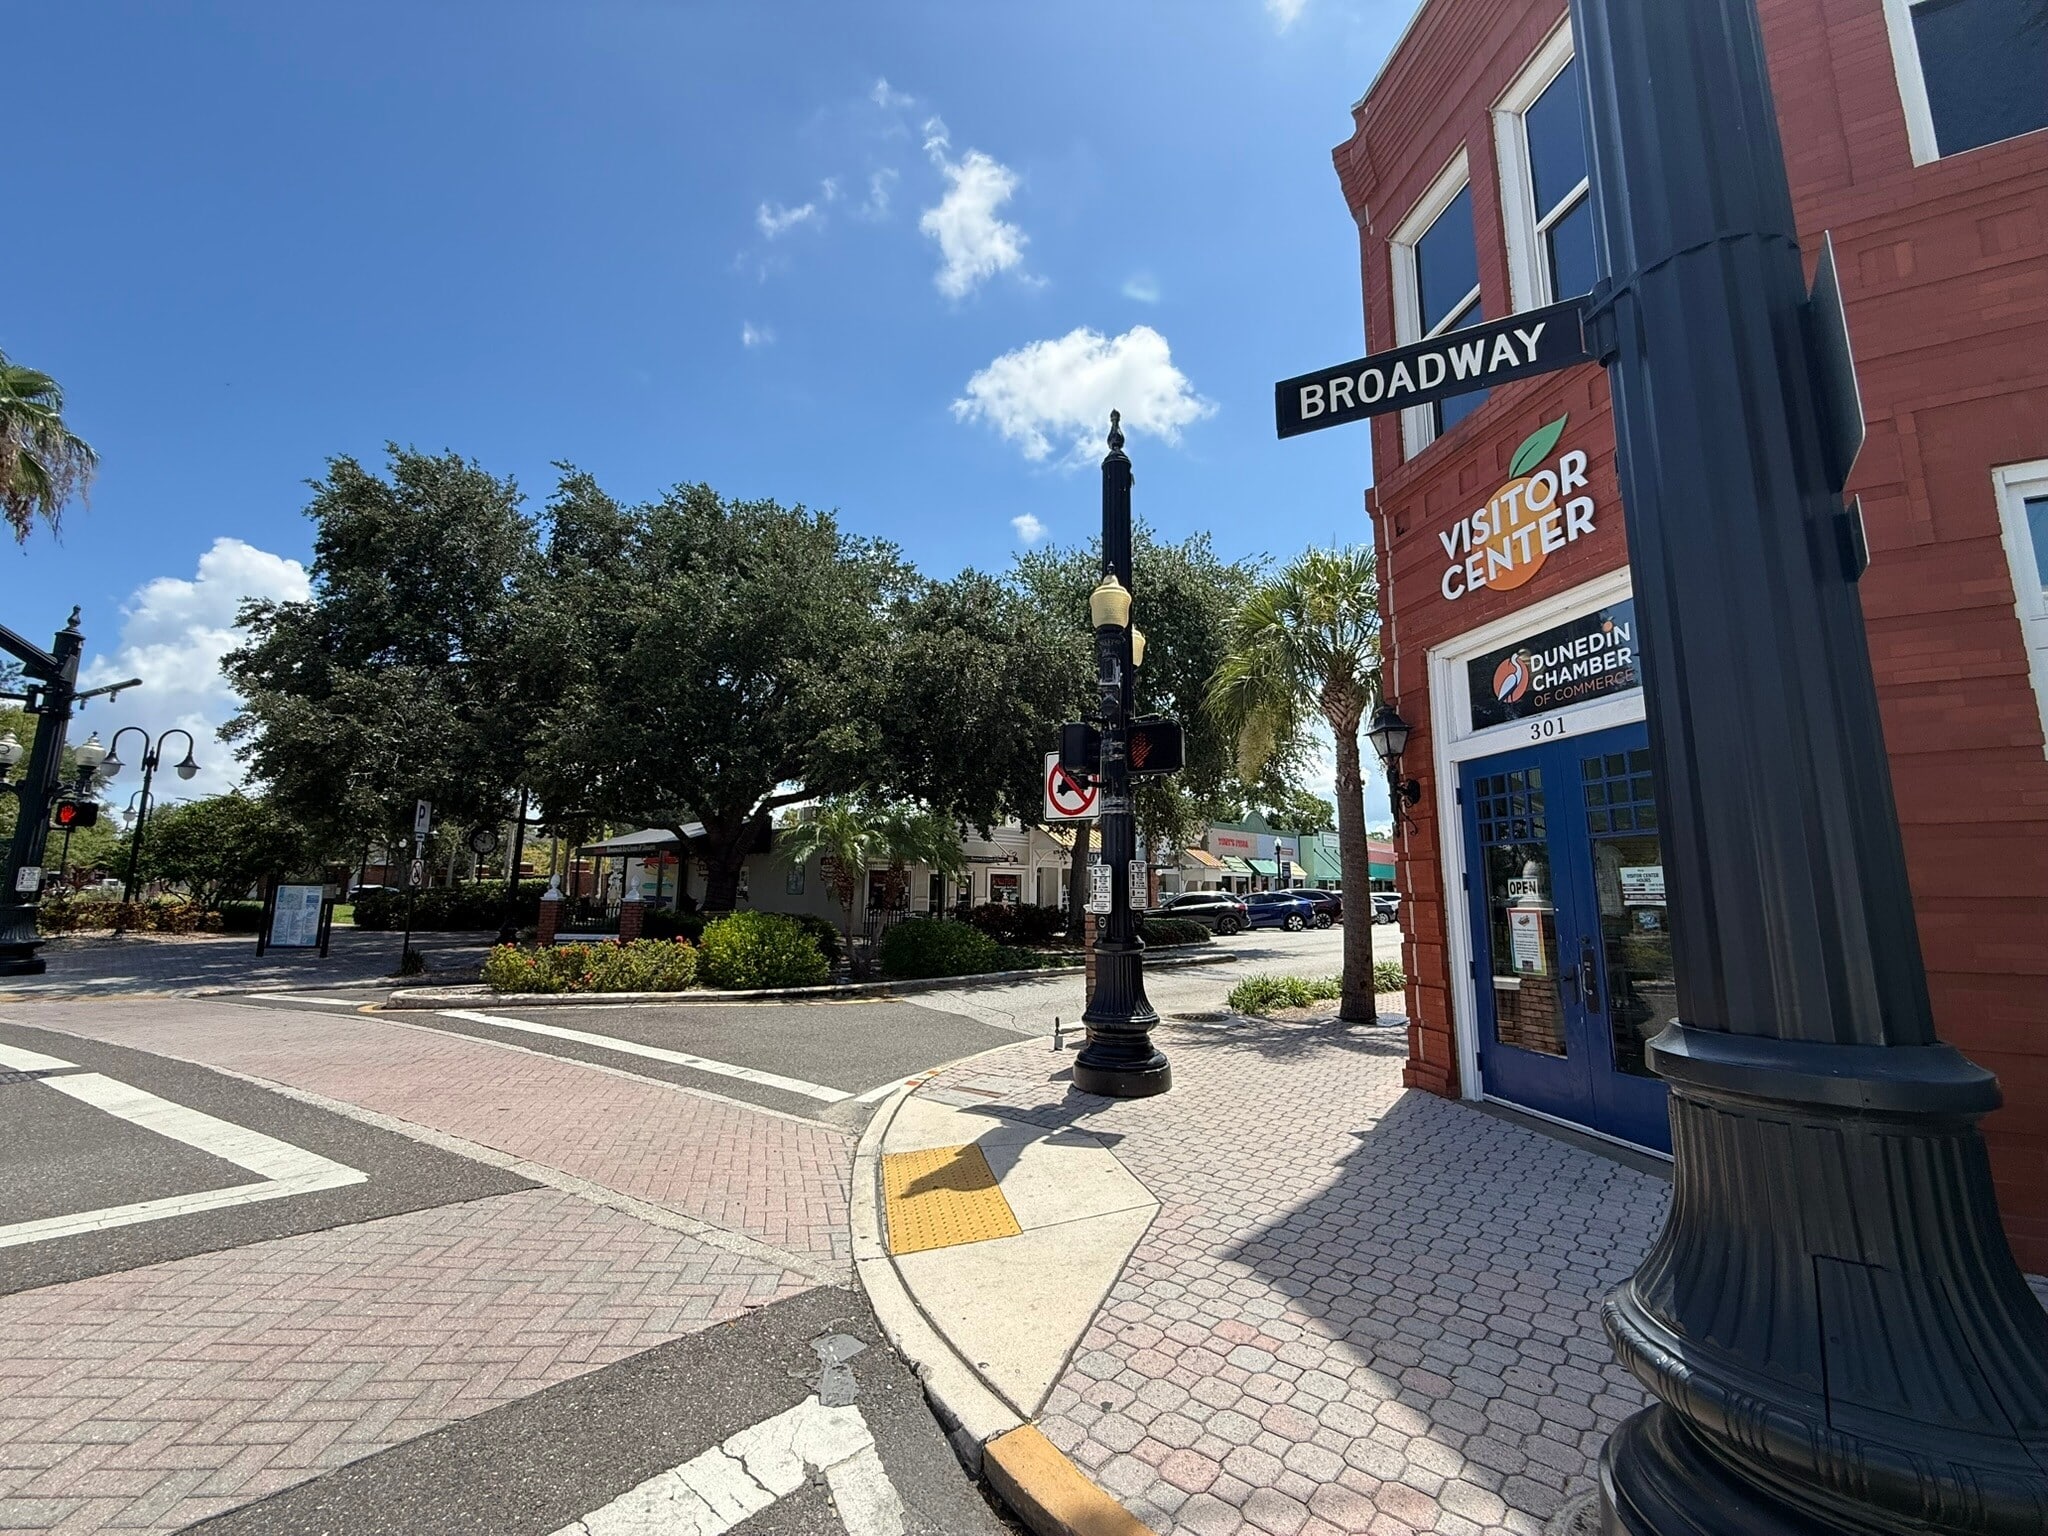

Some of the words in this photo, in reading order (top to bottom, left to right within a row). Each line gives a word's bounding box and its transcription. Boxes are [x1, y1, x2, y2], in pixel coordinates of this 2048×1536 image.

[1300, 322, 1546, 420] BROADWAY
[1438, 449, 1589, 561] VISITOR
[1441, 496, 1597, 600] CENTER
[1532, 647, 1633, 691] CHAMBER
[1534, 692, 1551, 707] OF
[1554, 668, 1634, 701] COMMERCE
[1530, 717, 1567, 740] 301
[418, 805, 426, 827] P
[1509, 881, 1537, 895] OPEN
